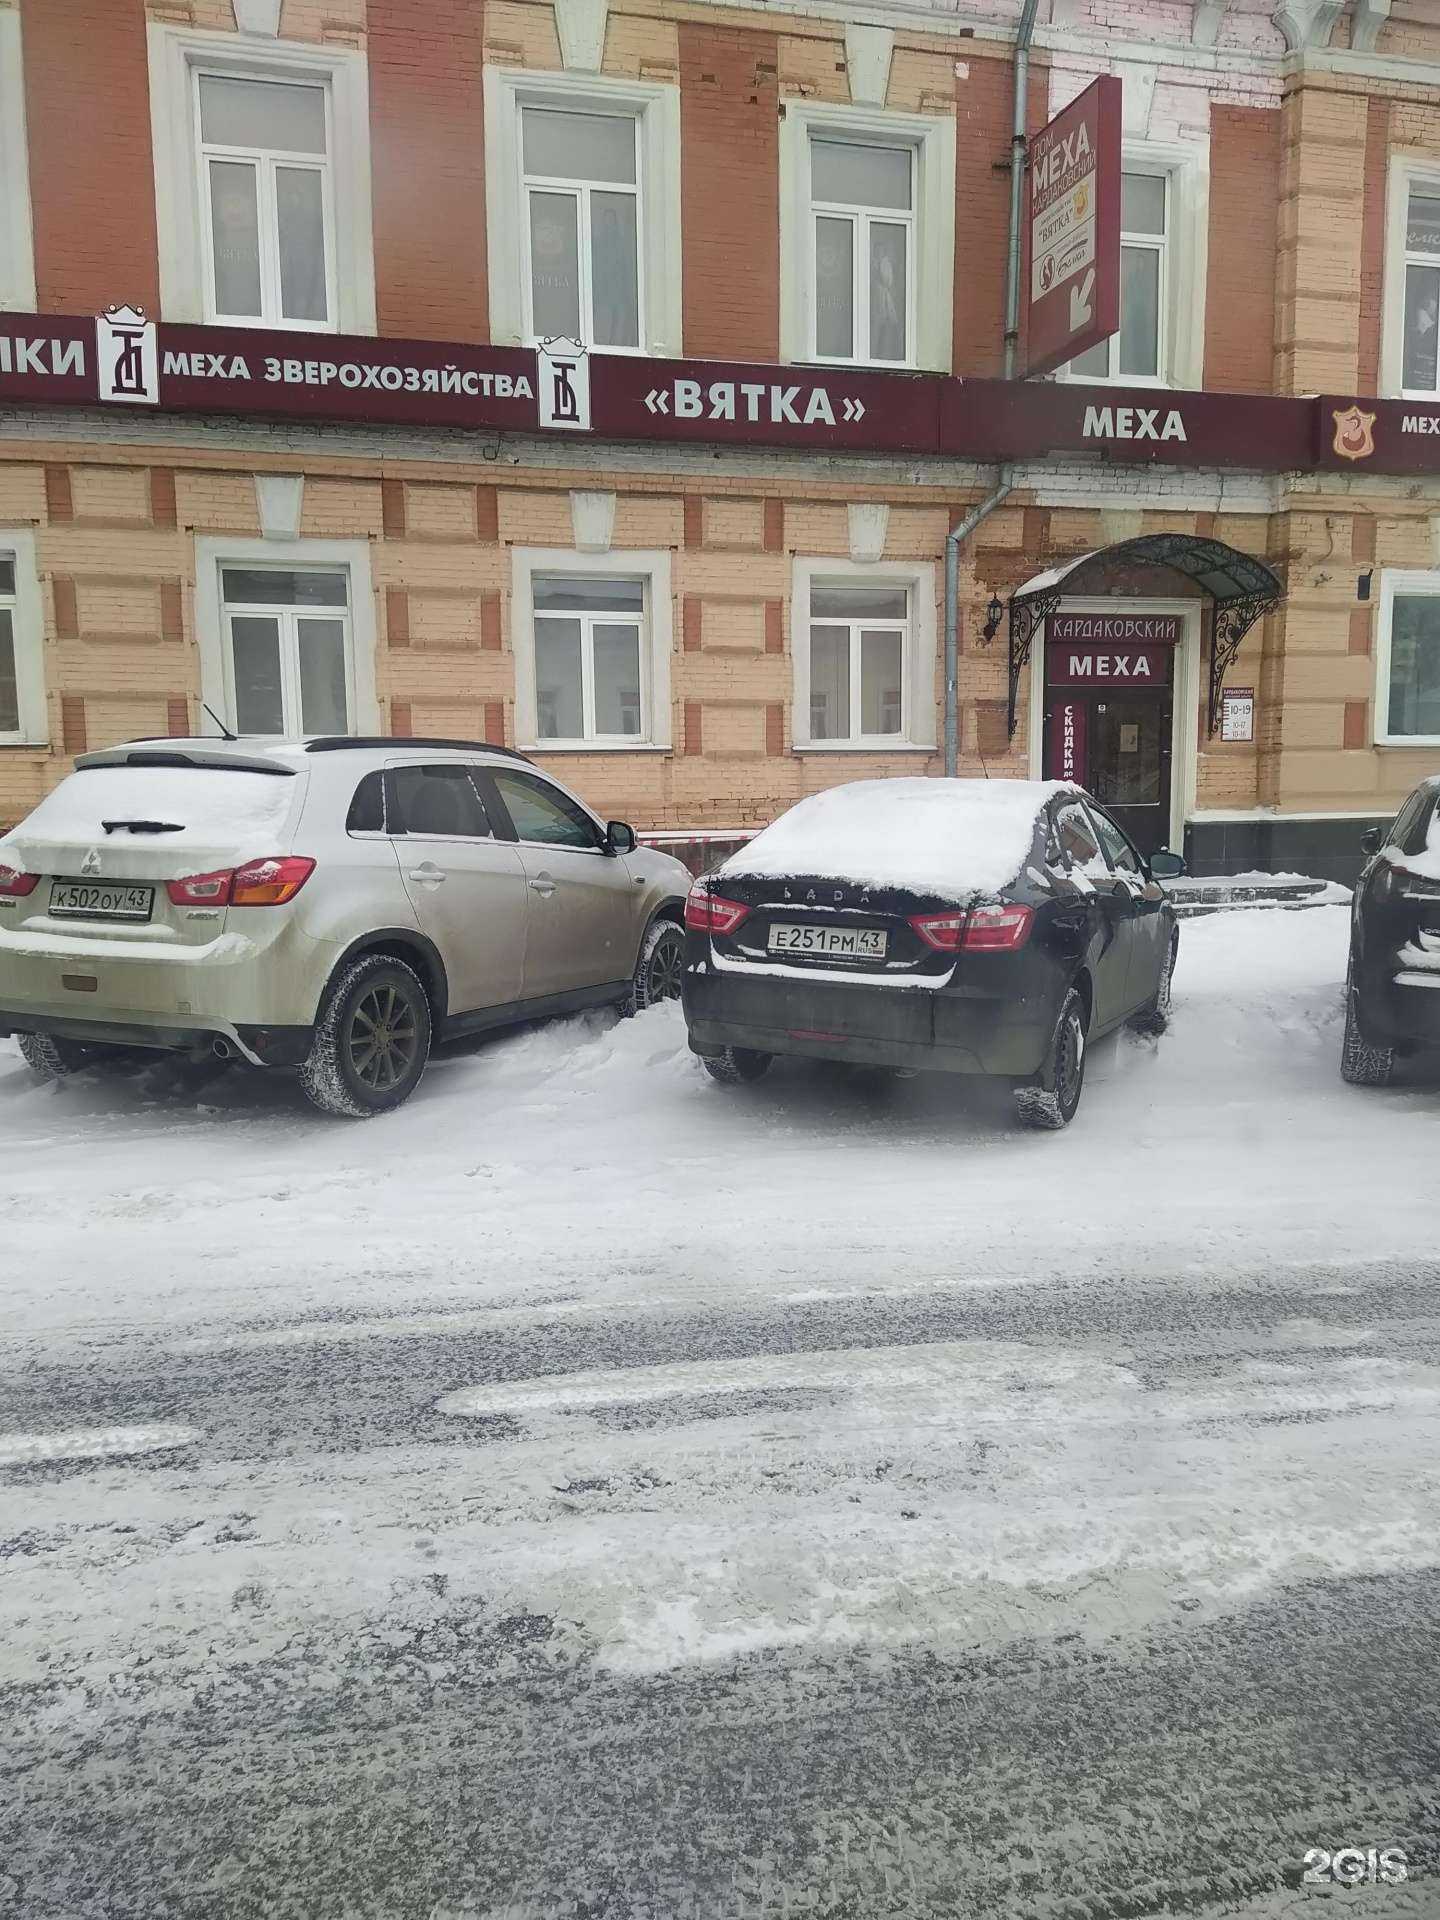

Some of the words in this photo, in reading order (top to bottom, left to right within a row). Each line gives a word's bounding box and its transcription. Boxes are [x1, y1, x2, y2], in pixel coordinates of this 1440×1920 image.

[1035, 130, 1055, 159] ДОМ
[1033, 122, 1090, 200] МЕХА
[0, 337, 86, 377] КИ
[163, 351, 251, 380] МЕХА
[265, 357, 534, 399] ЗВЕРОХОЗЯЙСТВА
[645, 379, 867, 426] «ВЯТКА»
[1082, 406, 1188, 442] МЕХА
[1054, 617, 1176, 639] КАРДАКОВСКИЙ
[1069, 655, 1151, 676] МЕХА
[1230, 704, 1251, 714] 10-19
[1063, 706, 1074, 769] СКИДКИ
[127, 889, 145, 906] 43
[860, 931, 880, 947] 43
